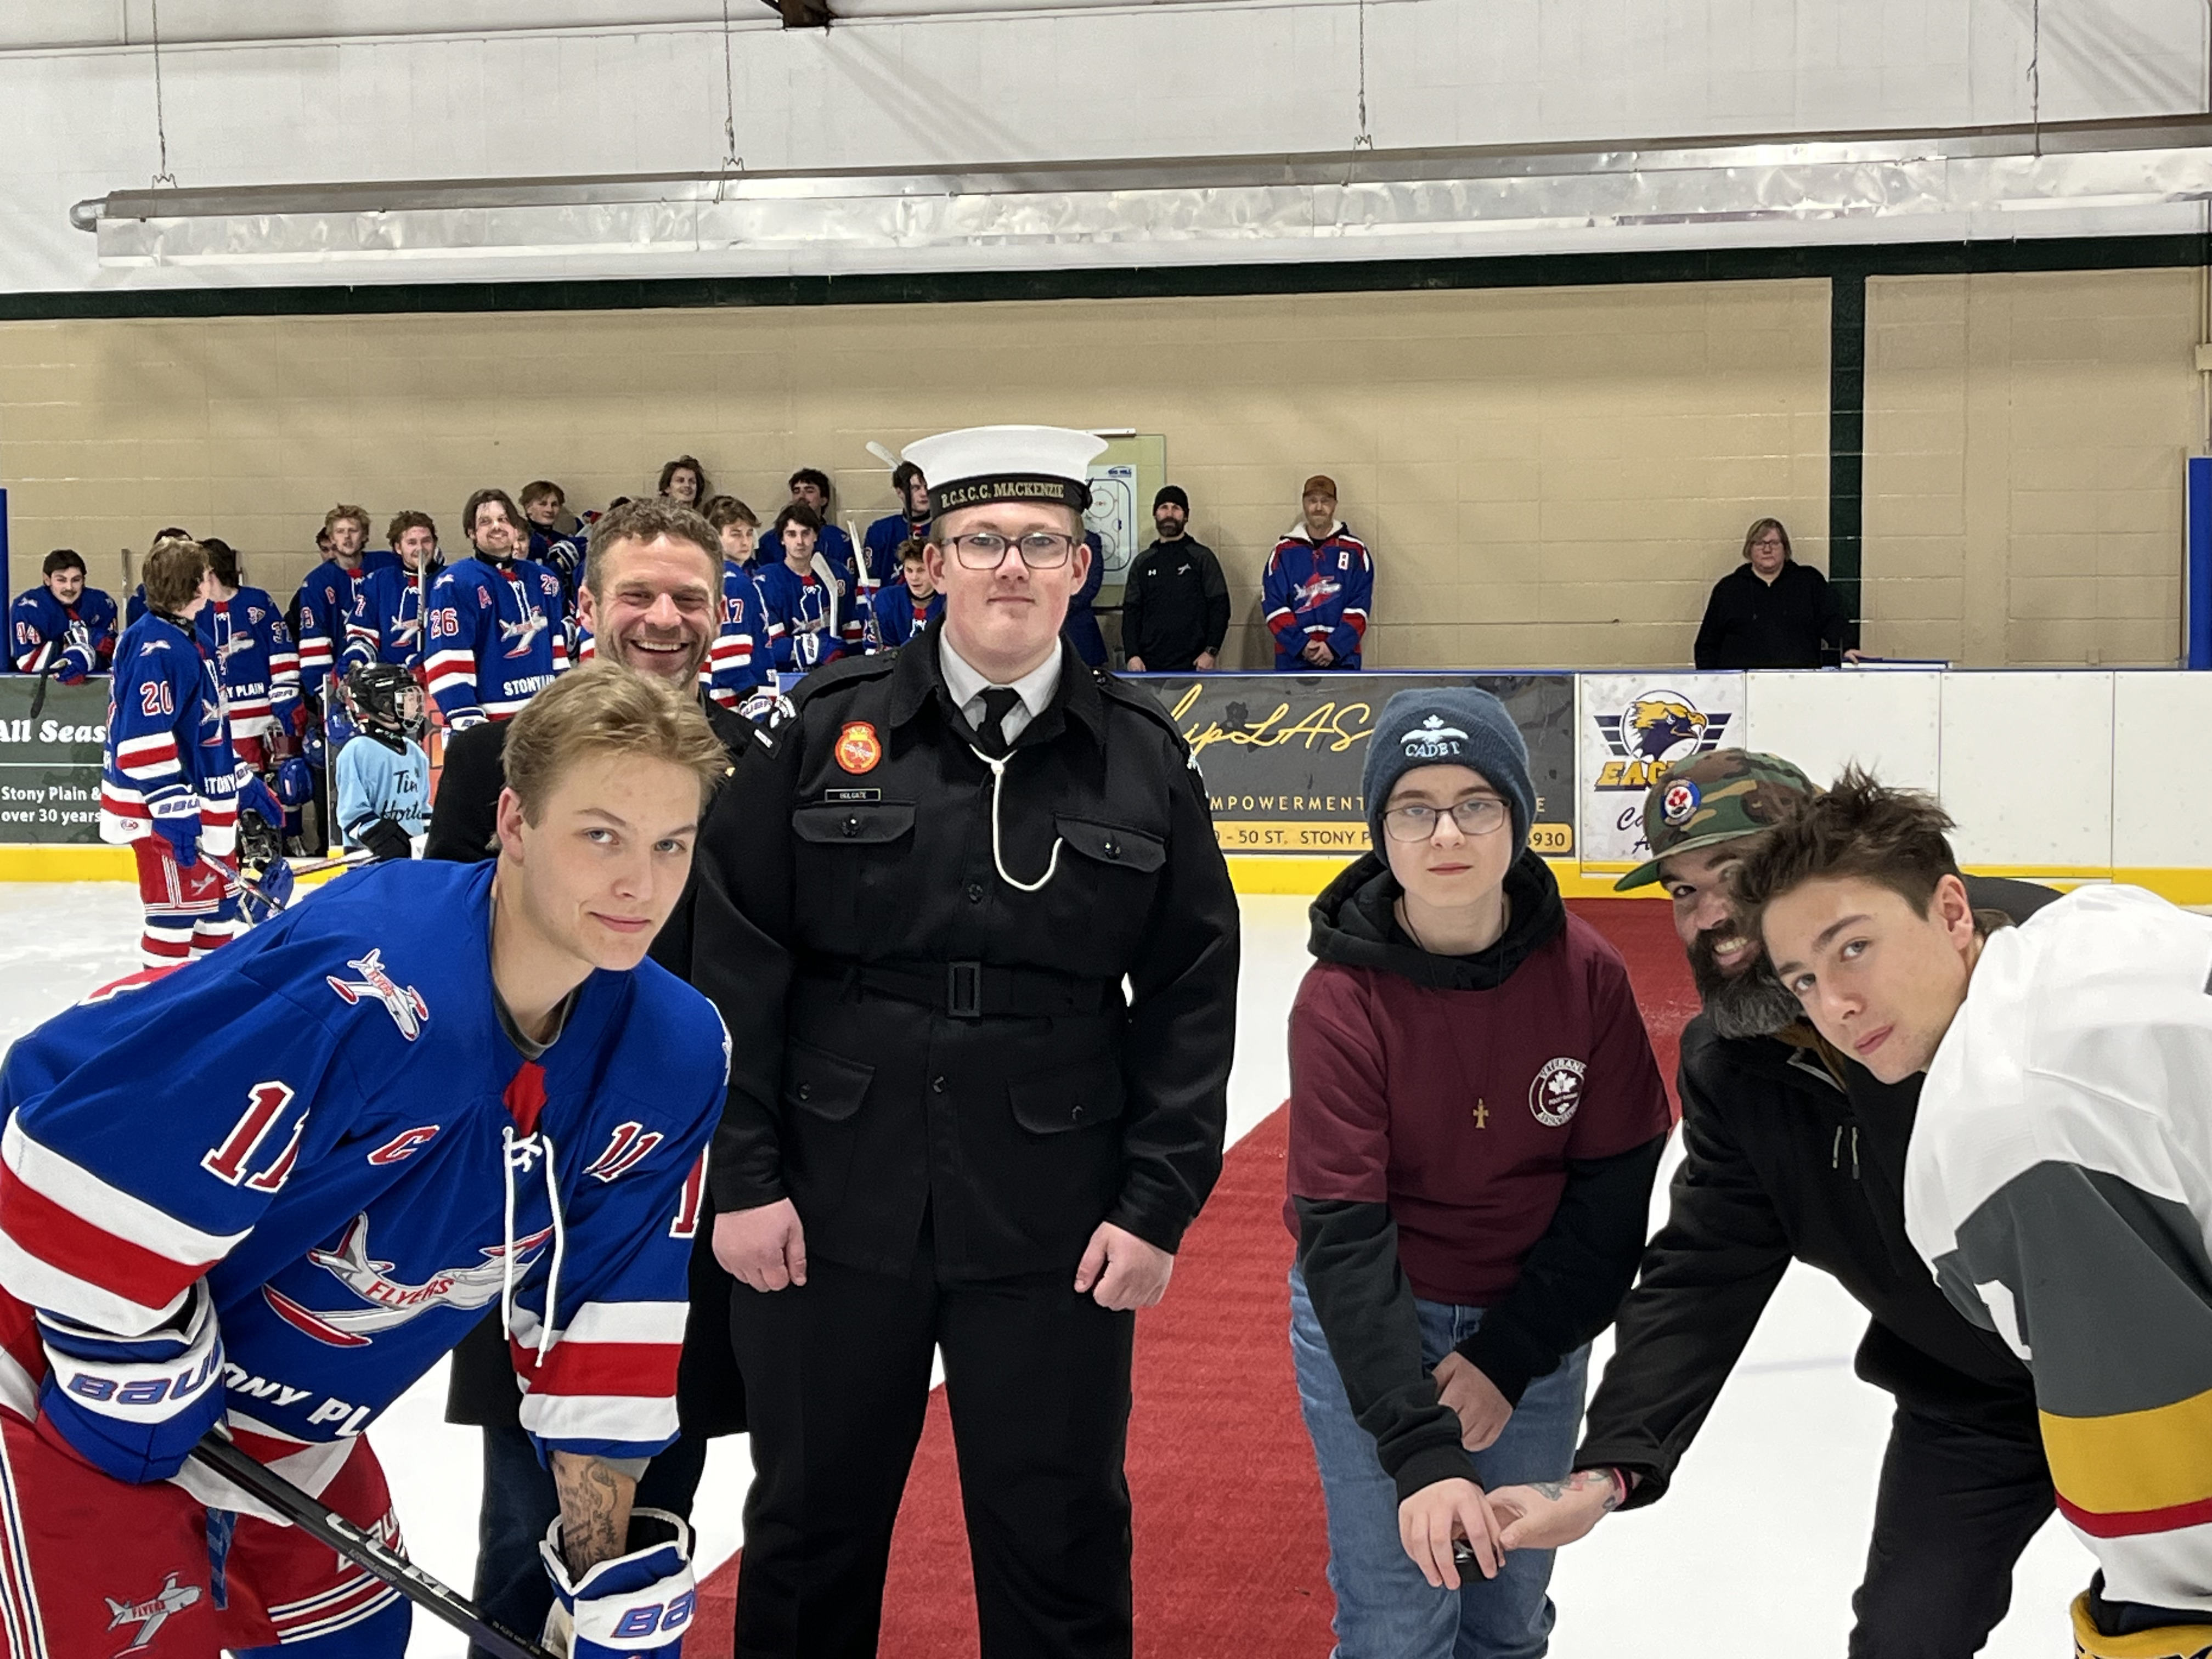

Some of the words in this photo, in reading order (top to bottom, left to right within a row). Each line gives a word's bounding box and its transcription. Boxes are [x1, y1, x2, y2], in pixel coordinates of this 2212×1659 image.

[993, 482, 1064, 499] MACKENZIE
[16, 621, 41, 645] 44
[430, 607, 459, 640] 26
[140, 680, 174, 716] 20
[236, 682, 264, 697] PLAIN
[1405, 741, 1461, 757] CADET
[1594, 760, 1677, 792] EAG
[1, 786, 45, 804] Stony
[48, 786, 87, 800] Plain
[1, 810, 35, 822] over
[39, 809, 58, 822] 30
[61, 811, 101, 826] years
[1239, 830, 1259, 844] 50
[1265, 830, 1288, 845] ST.
[1300, 830, 1355, 845] STONY
[367, 1125, 441, 1165] C
[365, 1278, 455, 1305] FLYERS
